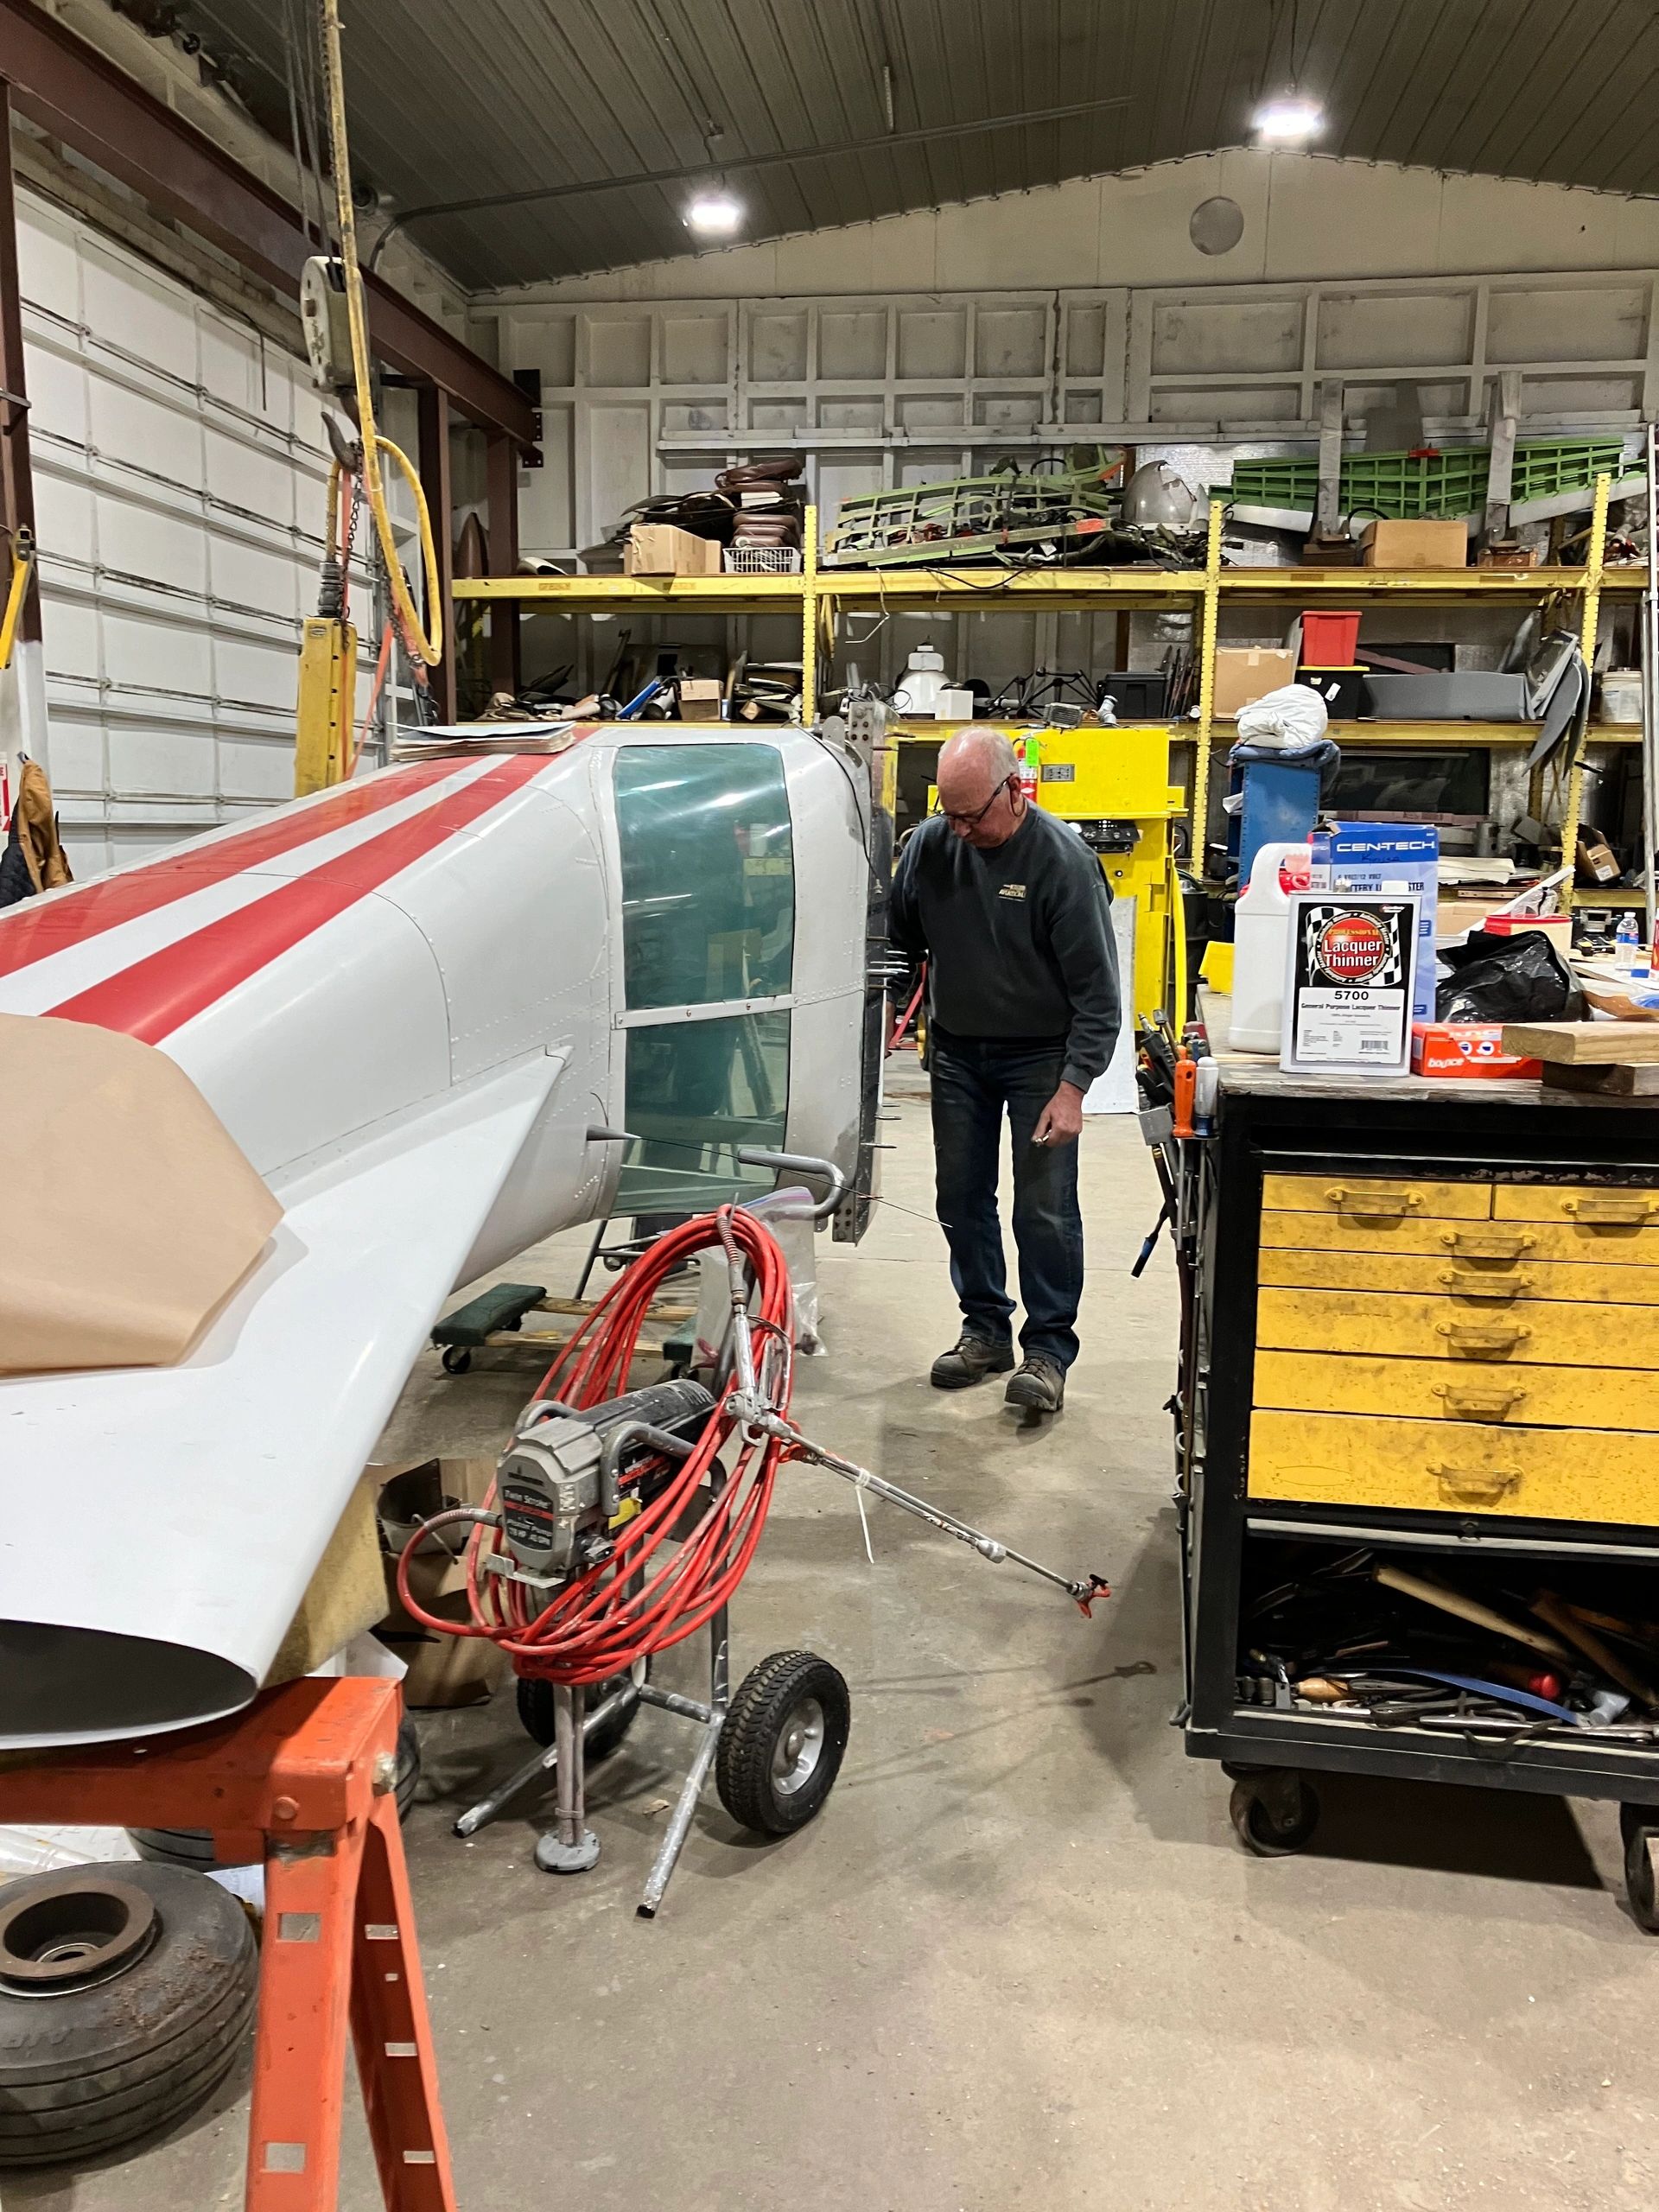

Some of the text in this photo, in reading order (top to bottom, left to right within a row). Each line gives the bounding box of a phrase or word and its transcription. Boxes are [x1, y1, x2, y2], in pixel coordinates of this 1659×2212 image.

[1324, 939, 1382, 955] Lacquer
[1324, 954, 1379, 967] Thinner
[1334, 990, 1370, 1001] 5700
